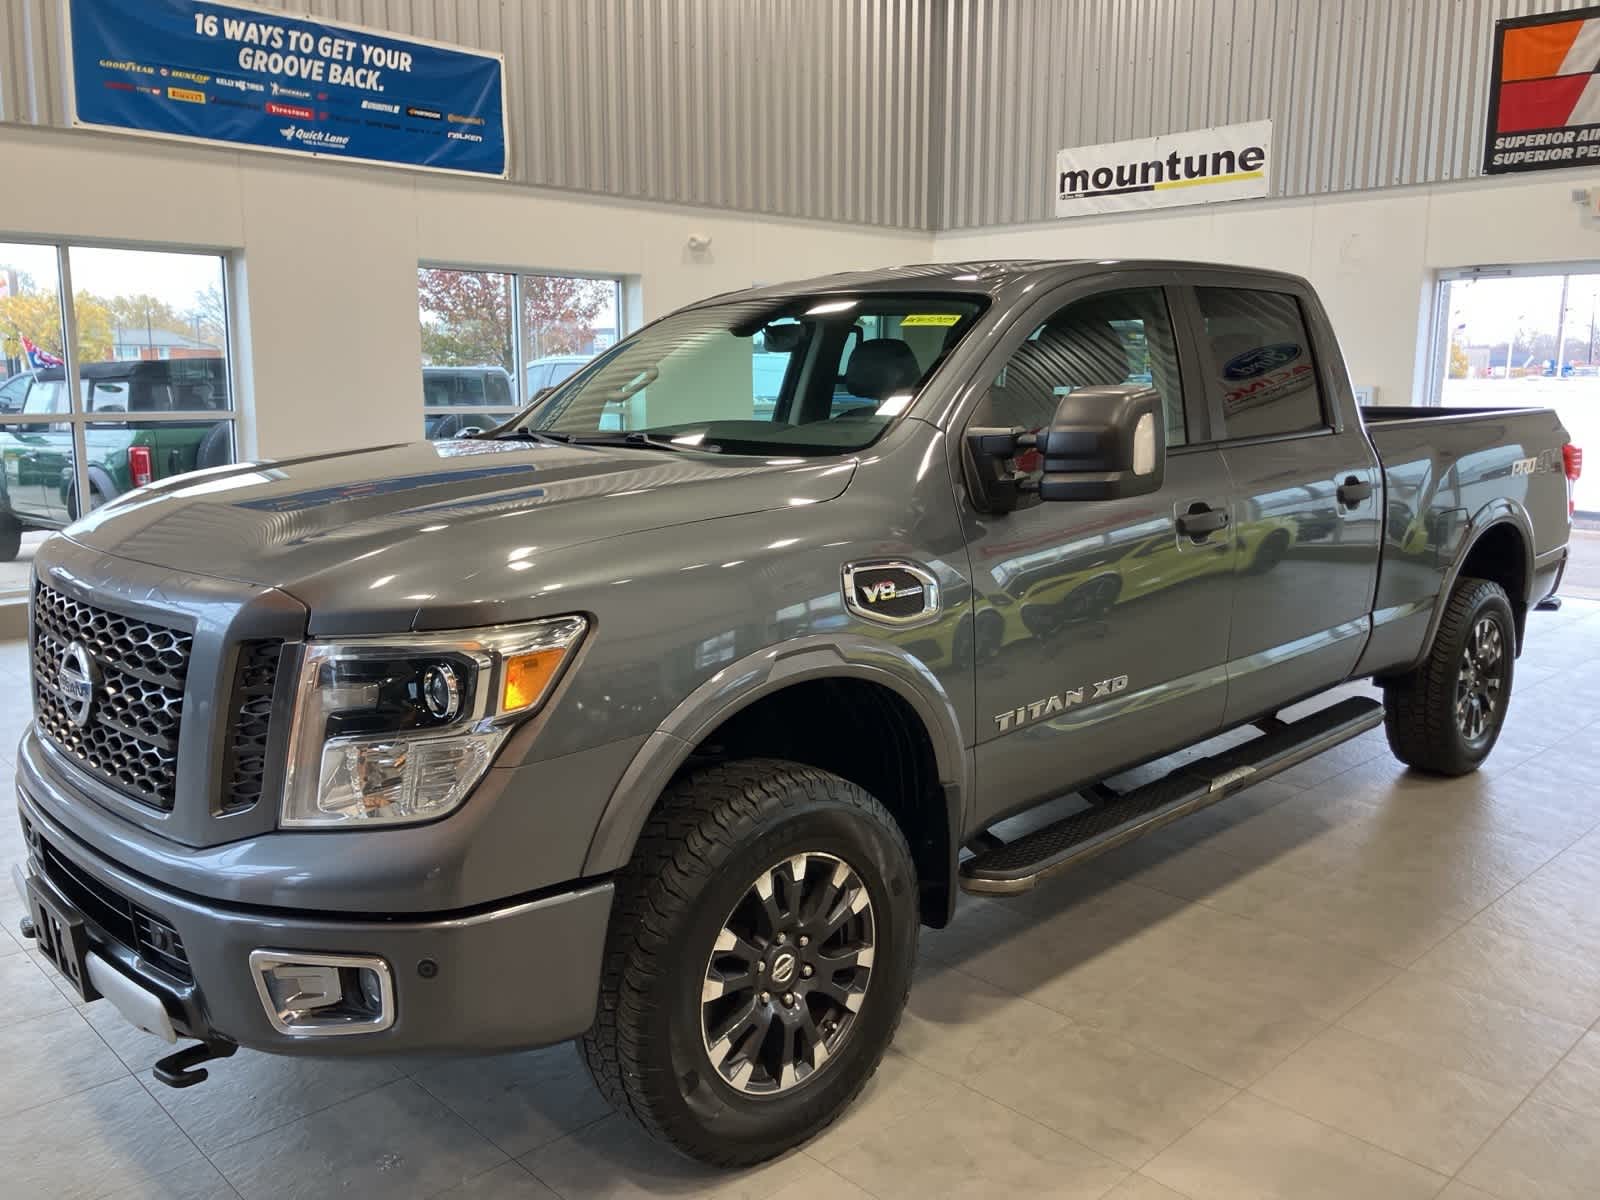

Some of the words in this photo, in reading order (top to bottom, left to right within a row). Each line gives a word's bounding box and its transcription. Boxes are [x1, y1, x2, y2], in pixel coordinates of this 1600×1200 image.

[194, 13, 218, 36] 16
[223, 18, 284, 48] WAYS
[288, 30, 314, 53] TO
[318, 36, 357, 61] GET
[361, 44, 412, 72] YOUR
[239, 47, 324, 81] GROOVE
[329, 64, 384, 92] BACK.
[295, 128, 325, 142] Quick
[324, 132, 349, 145] Lane
[447, 132, 482, 142] FALKEN
[1494, 131, 1576, 150] SUPERIOR
[1492, 147, 1574, 165] SUPERIOR
[1576, 145, 1600, 158] PE
[1059, 146, 1265, 193] mountune
[1512, 457, 1537, 477] PRO
[862, 581, 896, 603] V8
[993, 686, 1084, 732] TITAN
[1093, 674, 1129, 699] XD
